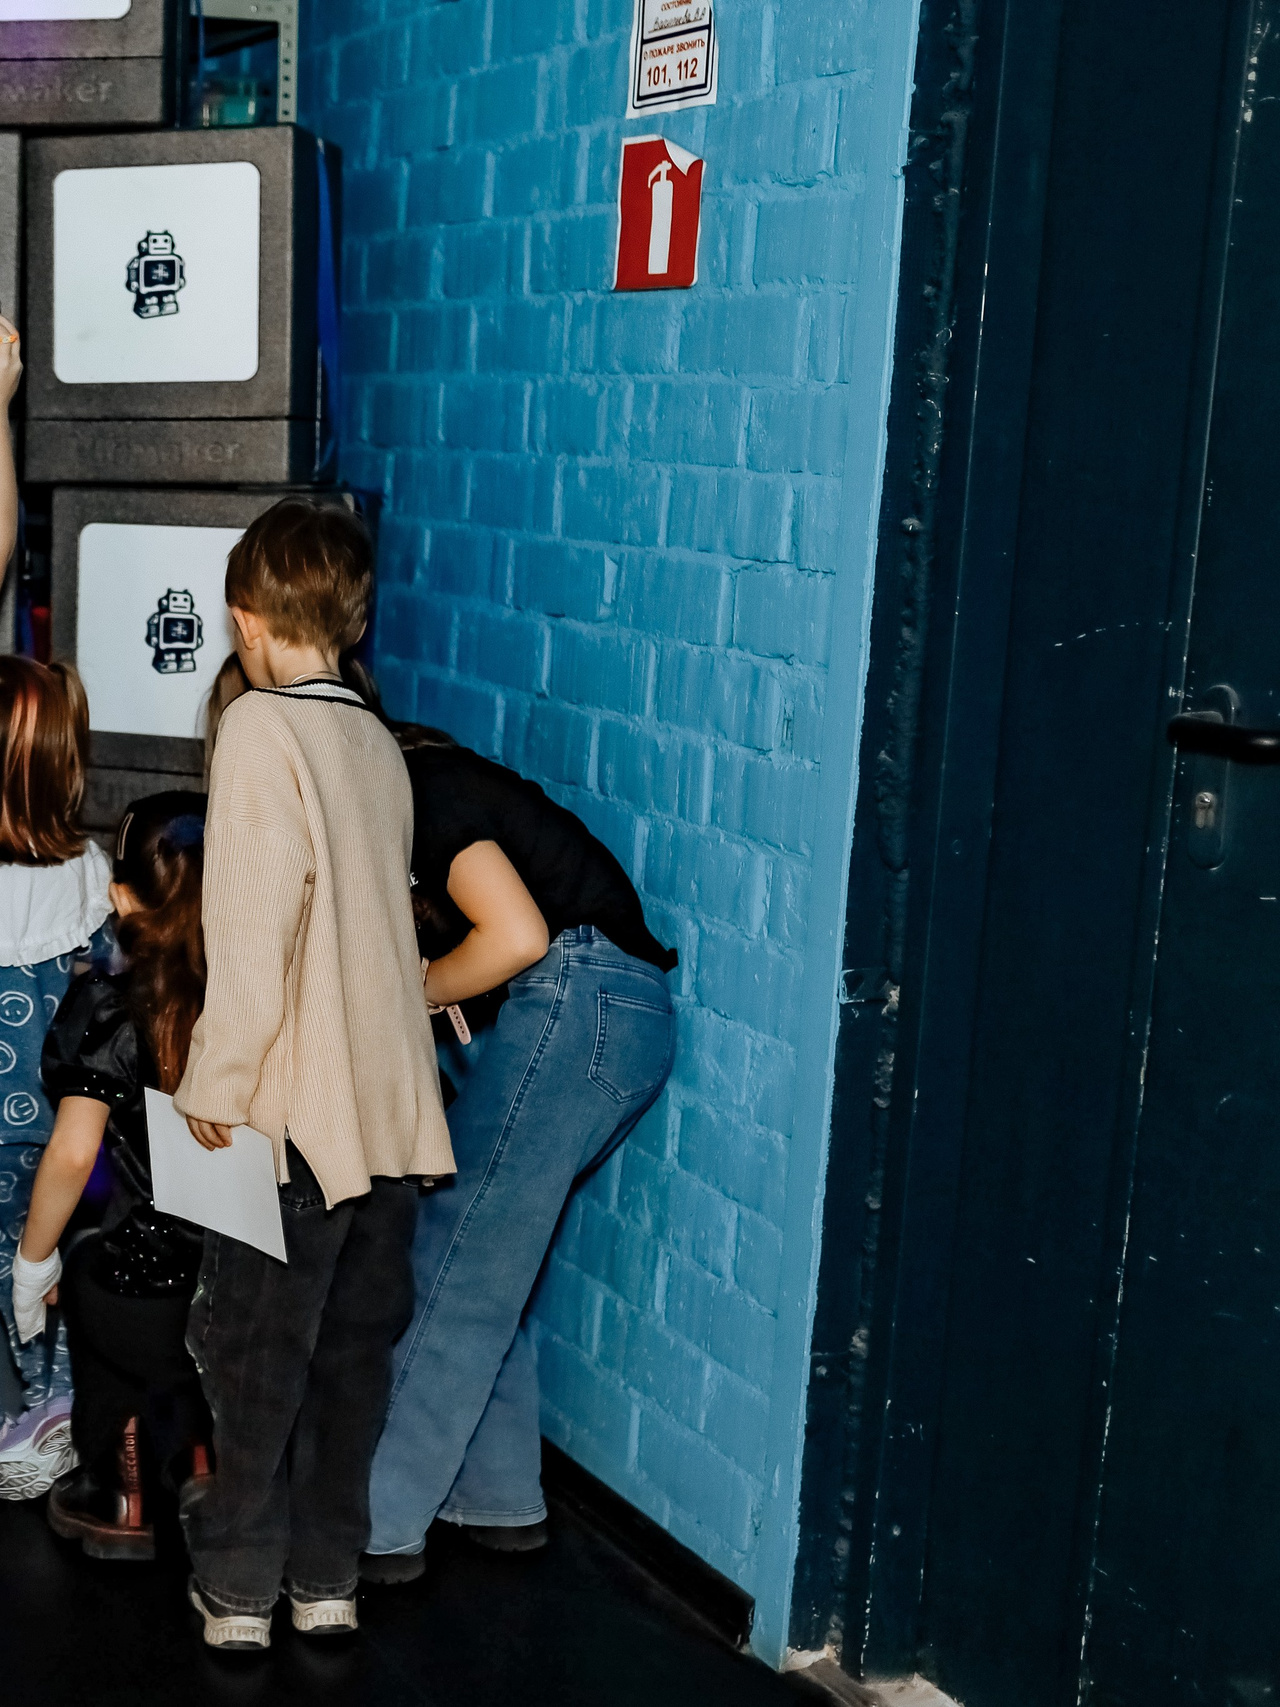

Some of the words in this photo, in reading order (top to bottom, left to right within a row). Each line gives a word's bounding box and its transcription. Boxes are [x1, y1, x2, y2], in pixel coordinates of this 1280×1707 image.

[676, 39, 705, 53] ЗВОНИТЬ
[646, 64, 672, 87] 101,
[677, 57, 698, 81] 112
